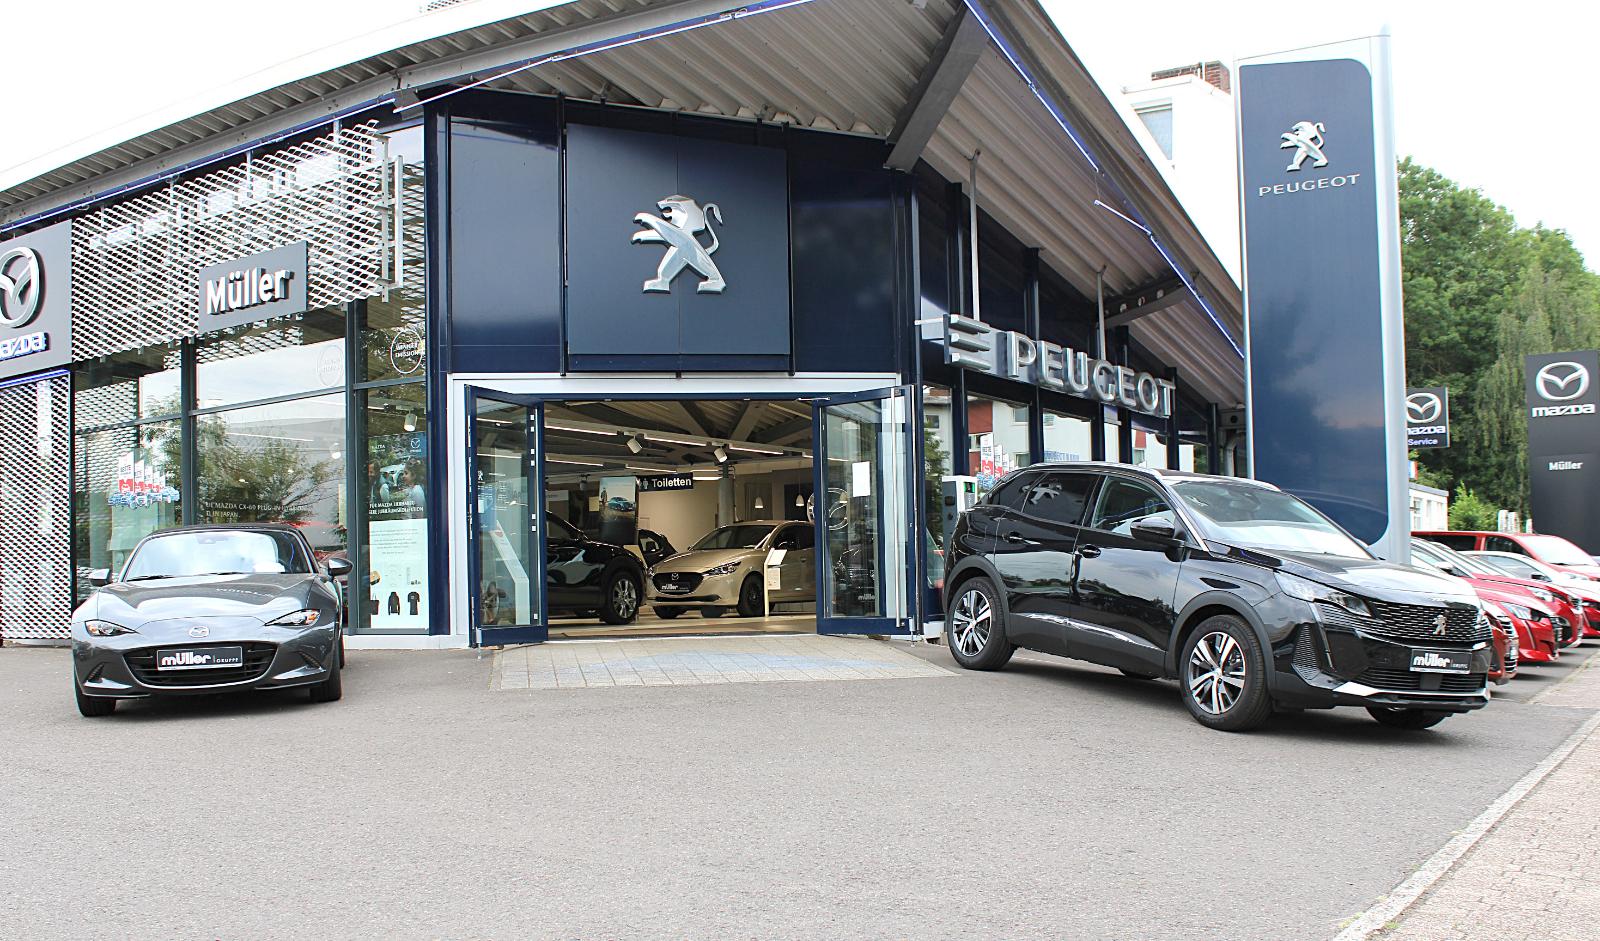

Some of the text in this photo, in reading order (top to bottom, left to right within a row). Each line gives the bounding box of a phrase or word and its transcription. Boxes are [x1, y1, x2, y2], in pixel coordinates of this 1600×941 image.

[1259, 174, 1360, 197] PEUGEOT
[207, 267, 290, 315] Müller
[0, 332, 46, 360] azda
[1006, 330, 1176, 417] PEUGEOT
[1532, 404, 1596, 418] mazda
[1407, 438, 1438, 446] Service
[1549, 461, 1583, 471] Müller
[651, 478, 692, 488] Toiletten
[214, 502, 237, 510] MAZDA
